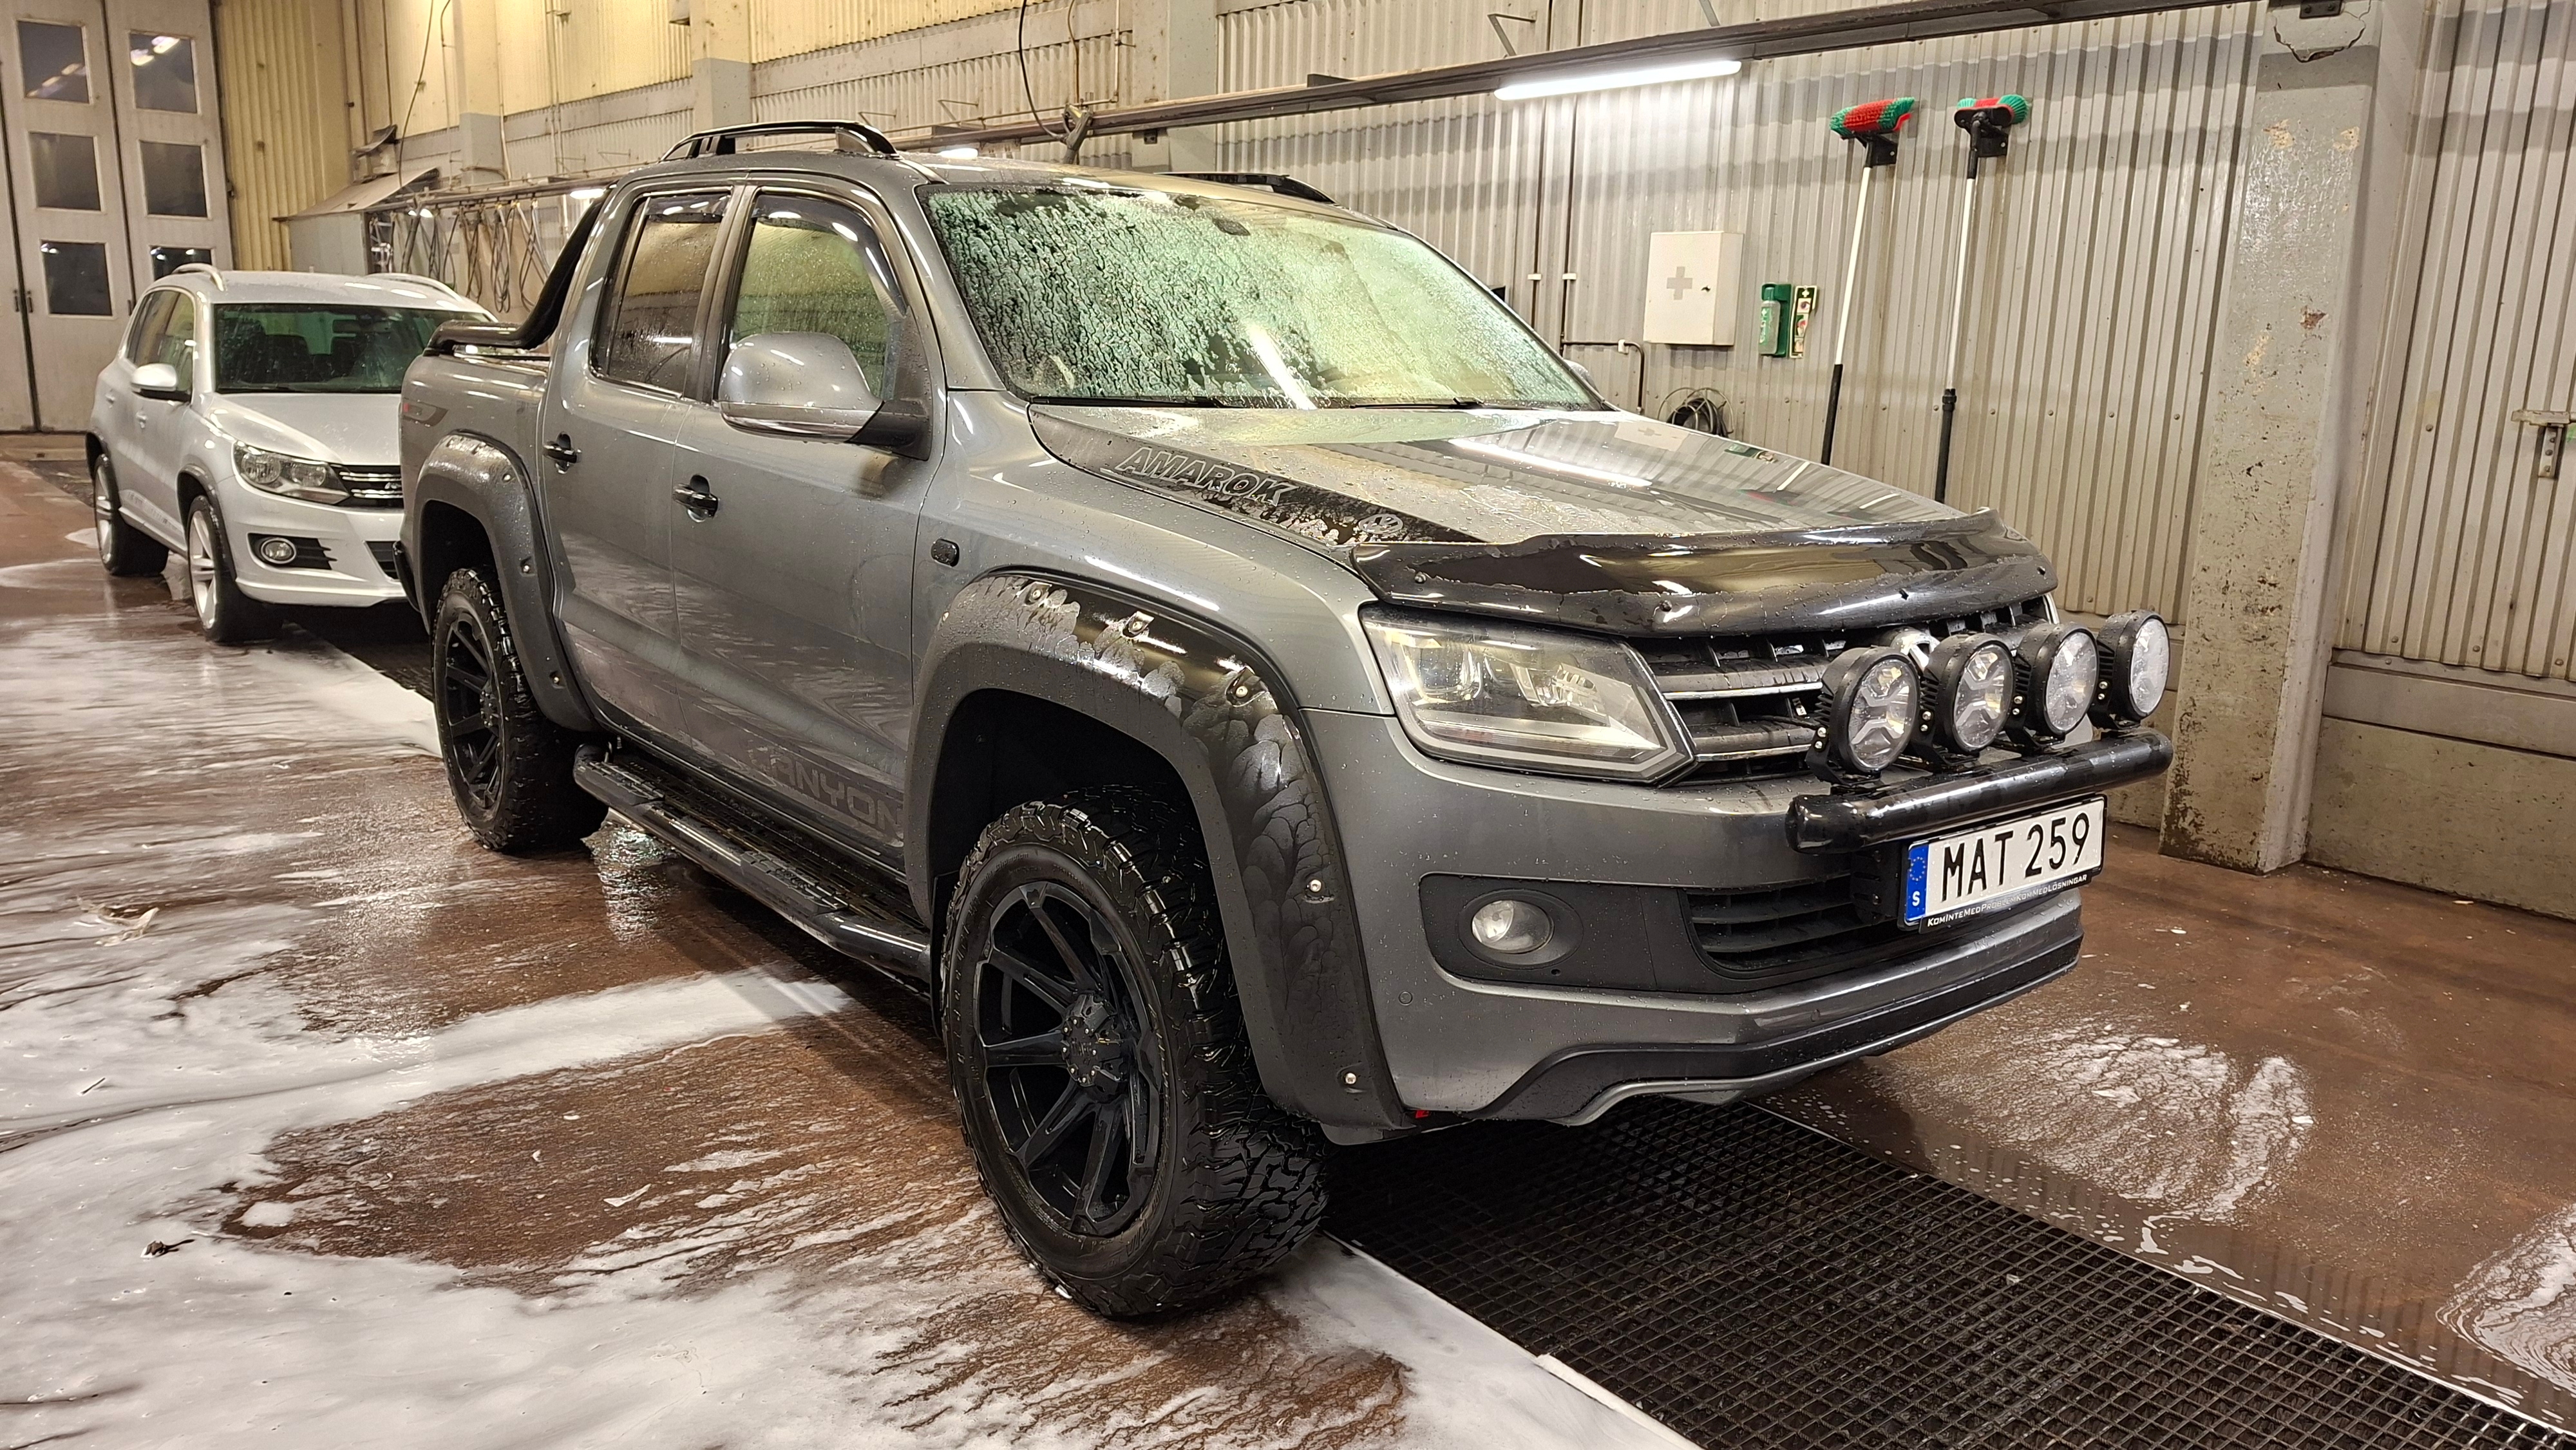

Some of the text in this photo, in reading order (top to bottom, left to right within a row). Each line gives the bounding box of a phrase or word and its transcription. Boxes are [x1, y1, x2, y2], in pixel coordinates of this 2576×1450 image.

[1114, 446, 1299, 507] AMAROK
[1942, 812, 2090, 901] MAT 259
[1912, 891, 1920, 907] S
